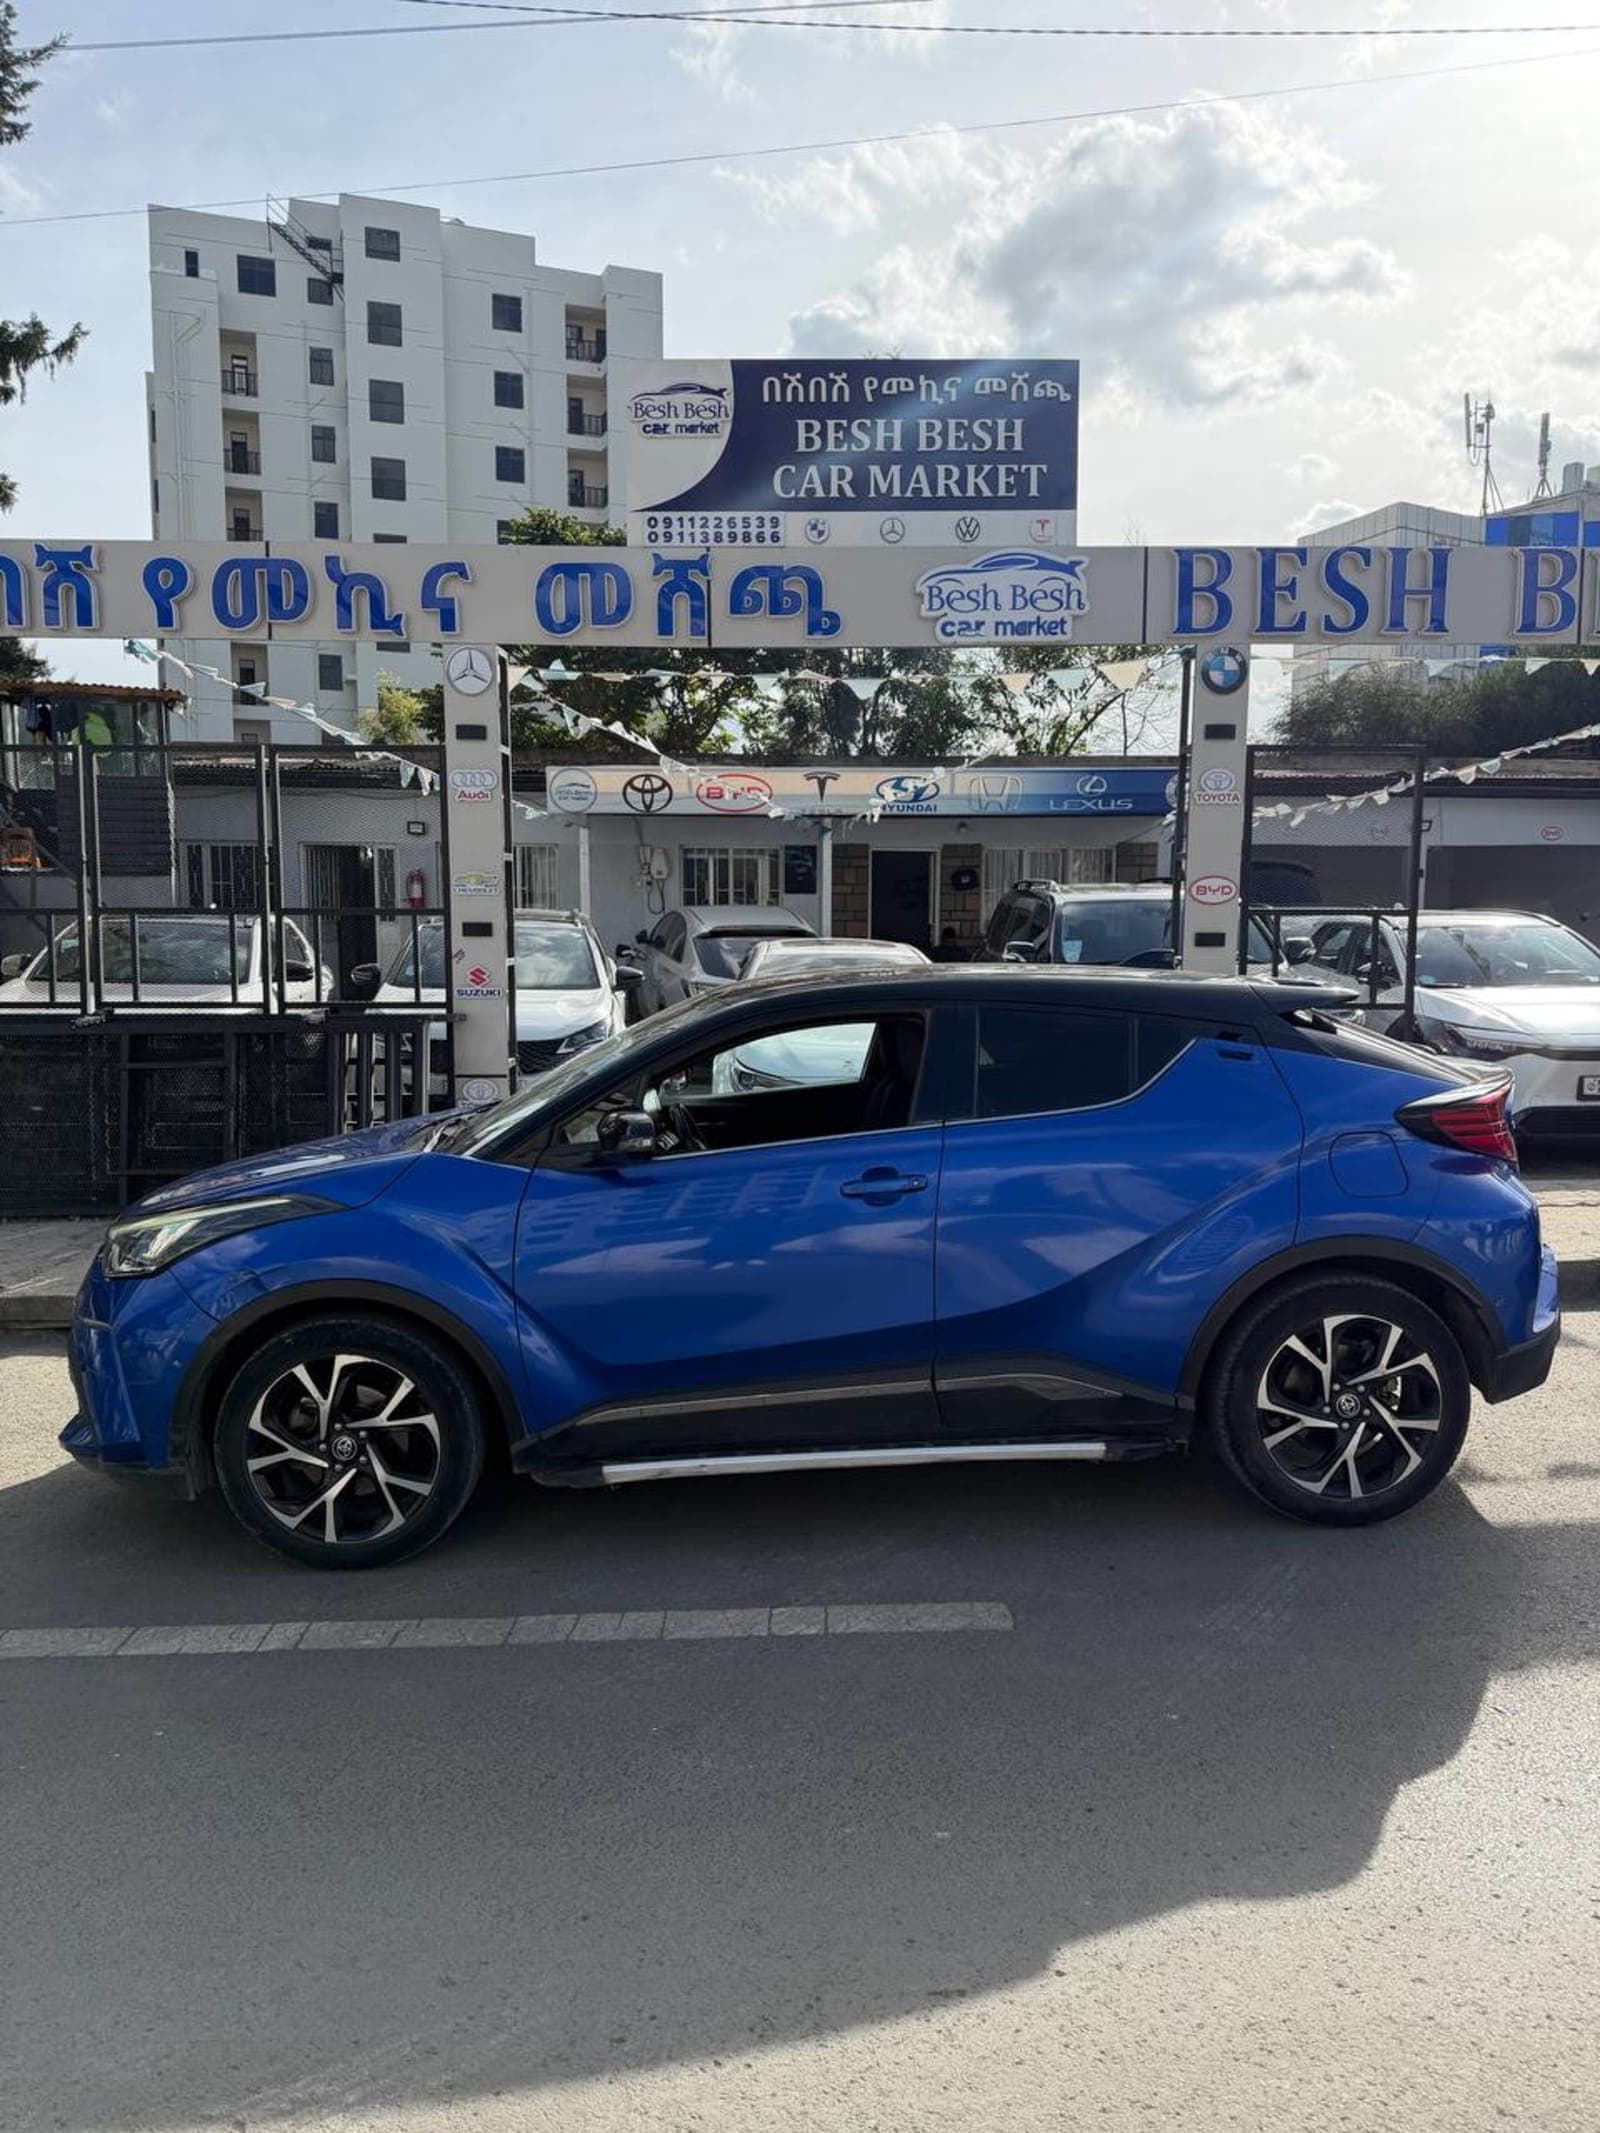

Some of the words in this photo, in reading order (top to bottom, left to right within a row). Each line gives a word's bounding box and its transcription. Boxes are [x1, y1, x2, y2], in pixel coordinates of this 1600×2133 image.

[763, 372, 850, 402] በሽበሽ
[863, 375, 962, 404] የመኪና
[634, 401, 679, 420] Besh
[684, 401, 730, 420] Besh
[642, 422, 670, 435] car
[674, 420, 720, 434] market
[796, 418, 903, 452] BESH
[917, 418, 1025, 452] BESH
[773, 463, 856, 498] CAR
[868, 463, 1048, 498] MARKET
[647, 516, 780, 529] 0911226539
[647, 531, 781, 543] 0911389866
[141, 554, 472, 637] የመኪና
[926, 582, 1002, 613] Besh
[1010, 582, 1086, 613] Besh
[1172, 546, 1454, 635] BESH
[1513, 546, 1600, 635] B
[940, 620, 986, 637] car
[994, 616, 1068, 637] market
[1050, 799, 1133, 810] LEXUS
[1195, 792, 1240, 802] TOYOTA
[1196, 885, 1233, 896] BYD
[456, 989, 501, 997] SUZUKI
